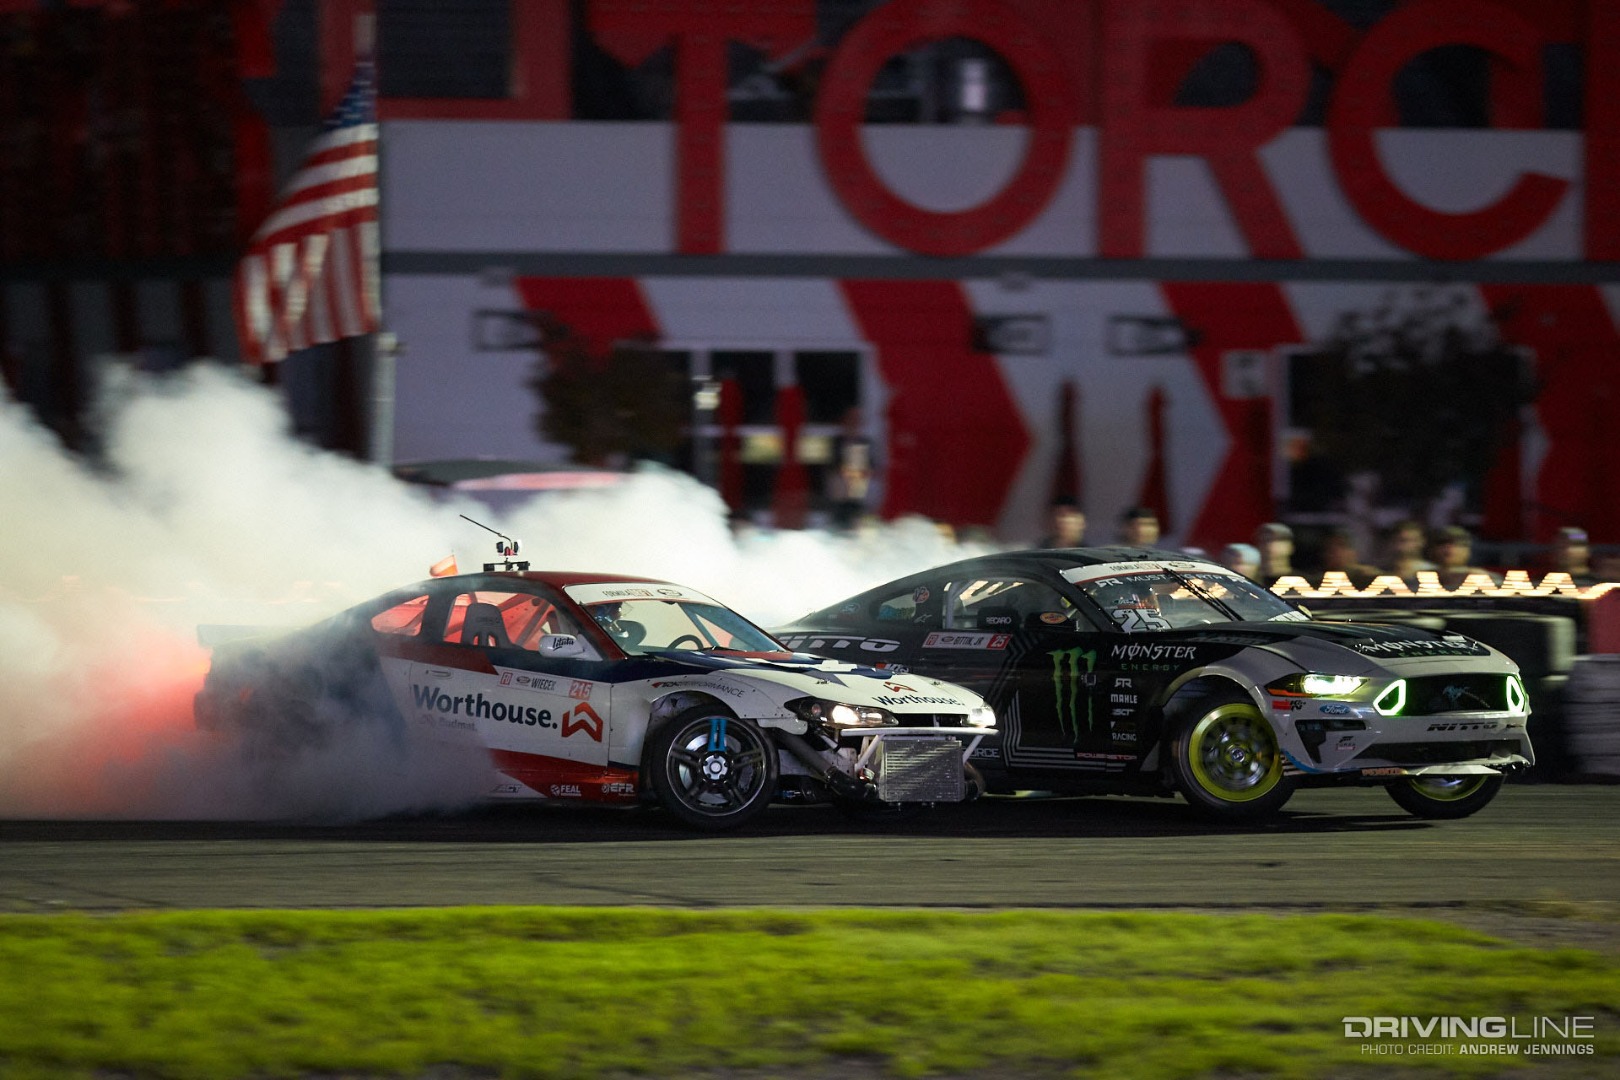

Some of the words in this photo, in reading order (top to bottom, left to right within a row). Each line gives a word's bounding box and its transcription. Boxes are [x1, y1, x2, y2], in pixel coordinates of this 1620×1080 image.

[586, 0, 1620, 258] TORC
[1127, 572, 1195, 583] MUSTG
[986, 616, 1012, 625] RECARO
[1112, 608, 1172, 631] 25
[991, 635, 1006, 648] 25
[1120, 663, 1181, 672] ENERGY
[569, 681, 591, 697] 215
[1110, 693, 1138, 705] MAHLE
[412, 683, 559, 730] Worthouse.
[1323, 705, 1347, 715] Ford
[1426, 721, 1499, 732] NITTO
[1111, 732, 1137, 742] RACING
[963, 747, 1000, 759] ORCE
[560, 785, 581, 794] FEAL
[609, 783, 635, 793] EFR
